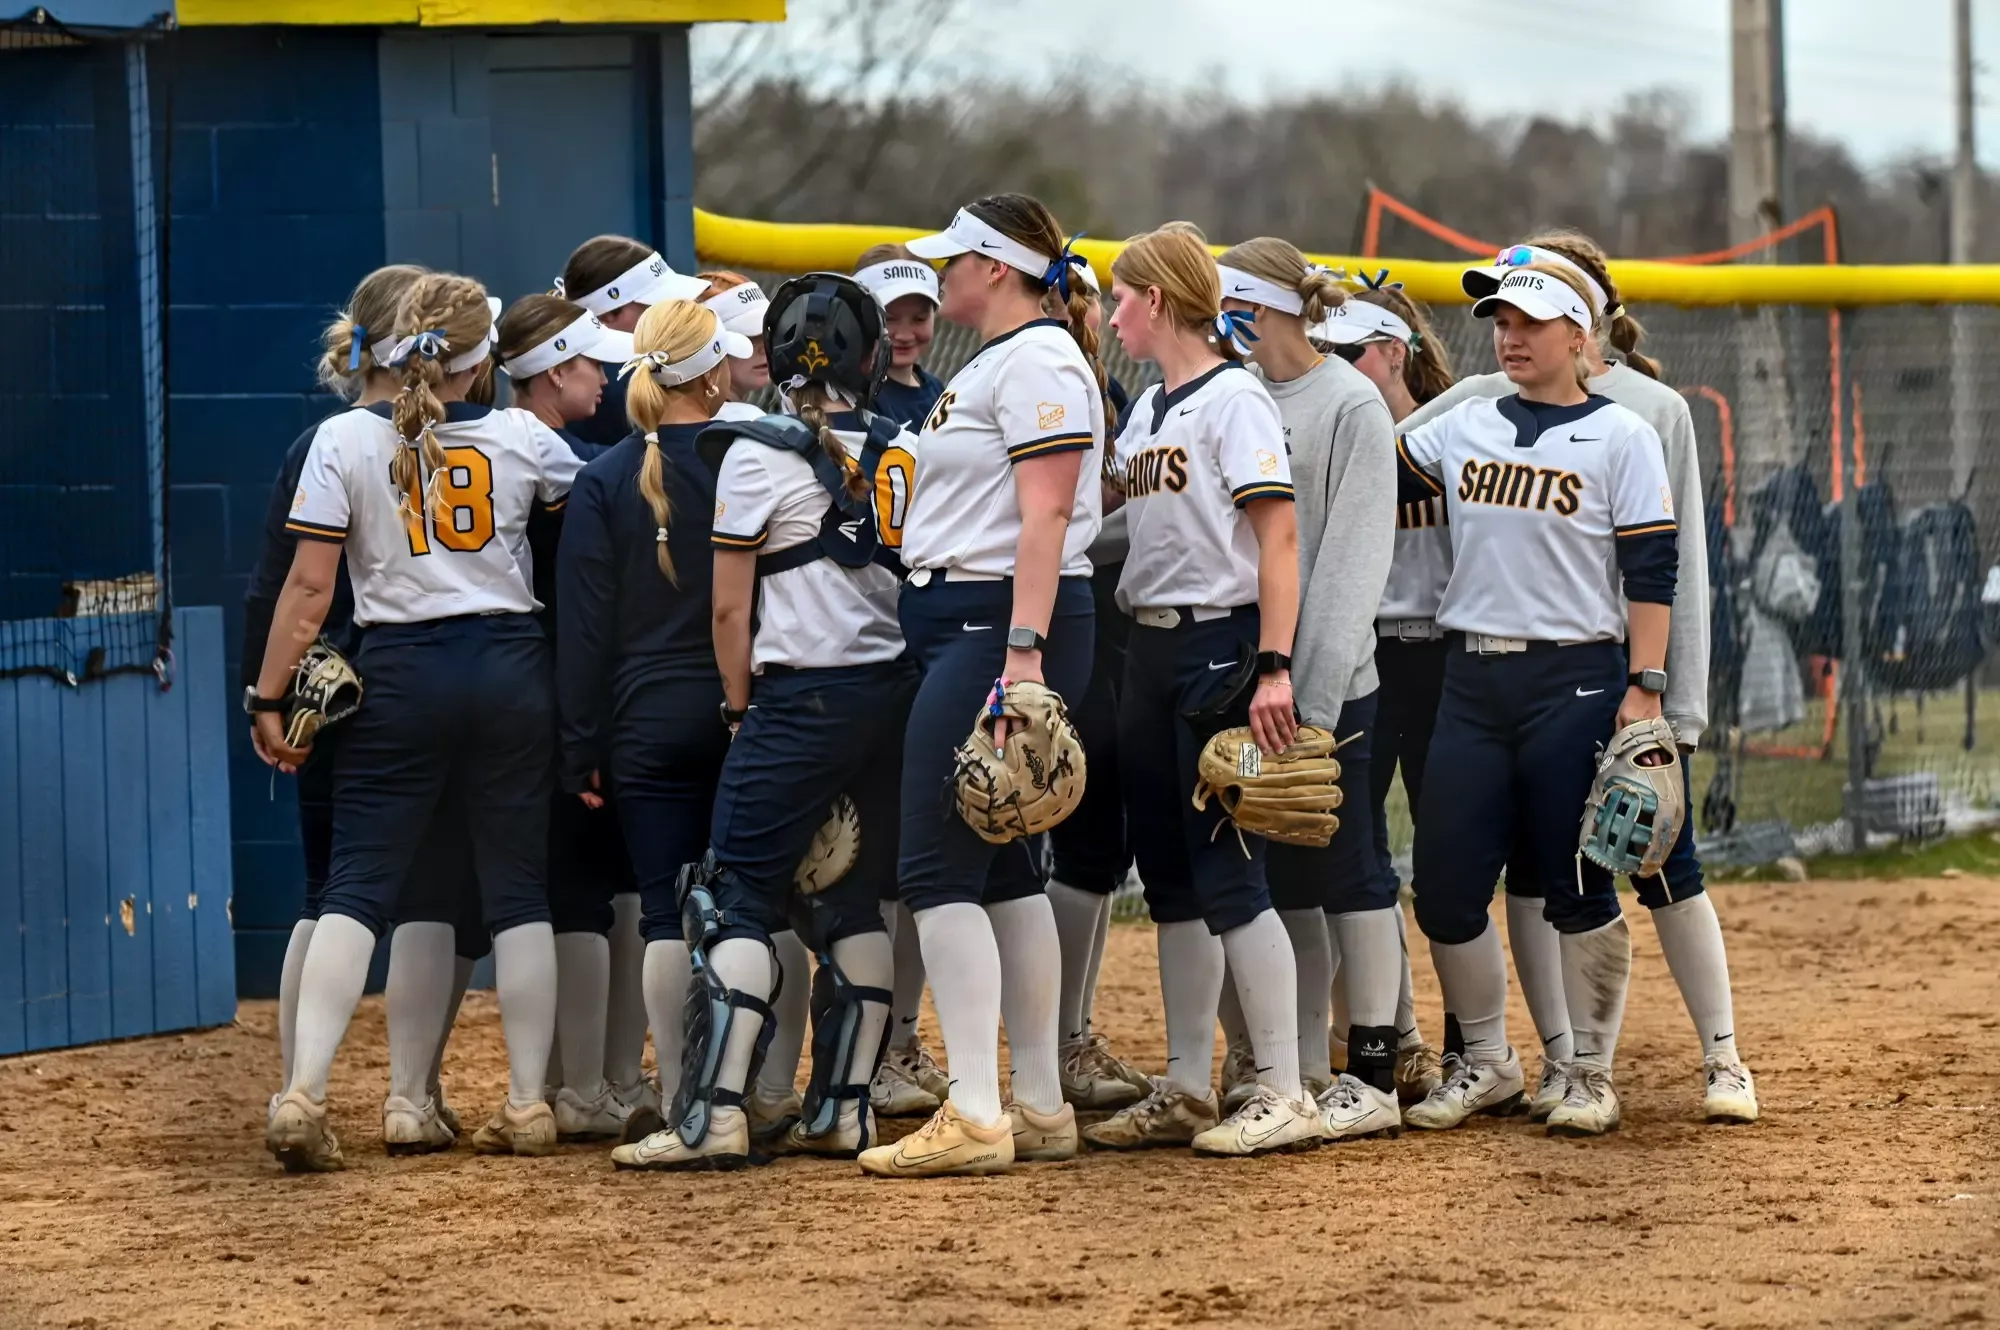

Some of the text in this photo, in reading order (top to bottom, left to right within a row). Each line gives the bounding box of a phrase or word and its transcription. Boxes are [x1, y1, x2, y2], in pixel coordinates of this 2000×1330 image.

[883, 266, 927, 281] SAINTS
[1501, 275, 1544, 290] SAINTS
[1125, 446, 1189, 499] AINTS
[1458, 458, 1583, 517] SAINTS
[388, 445, 496, 557] 18
